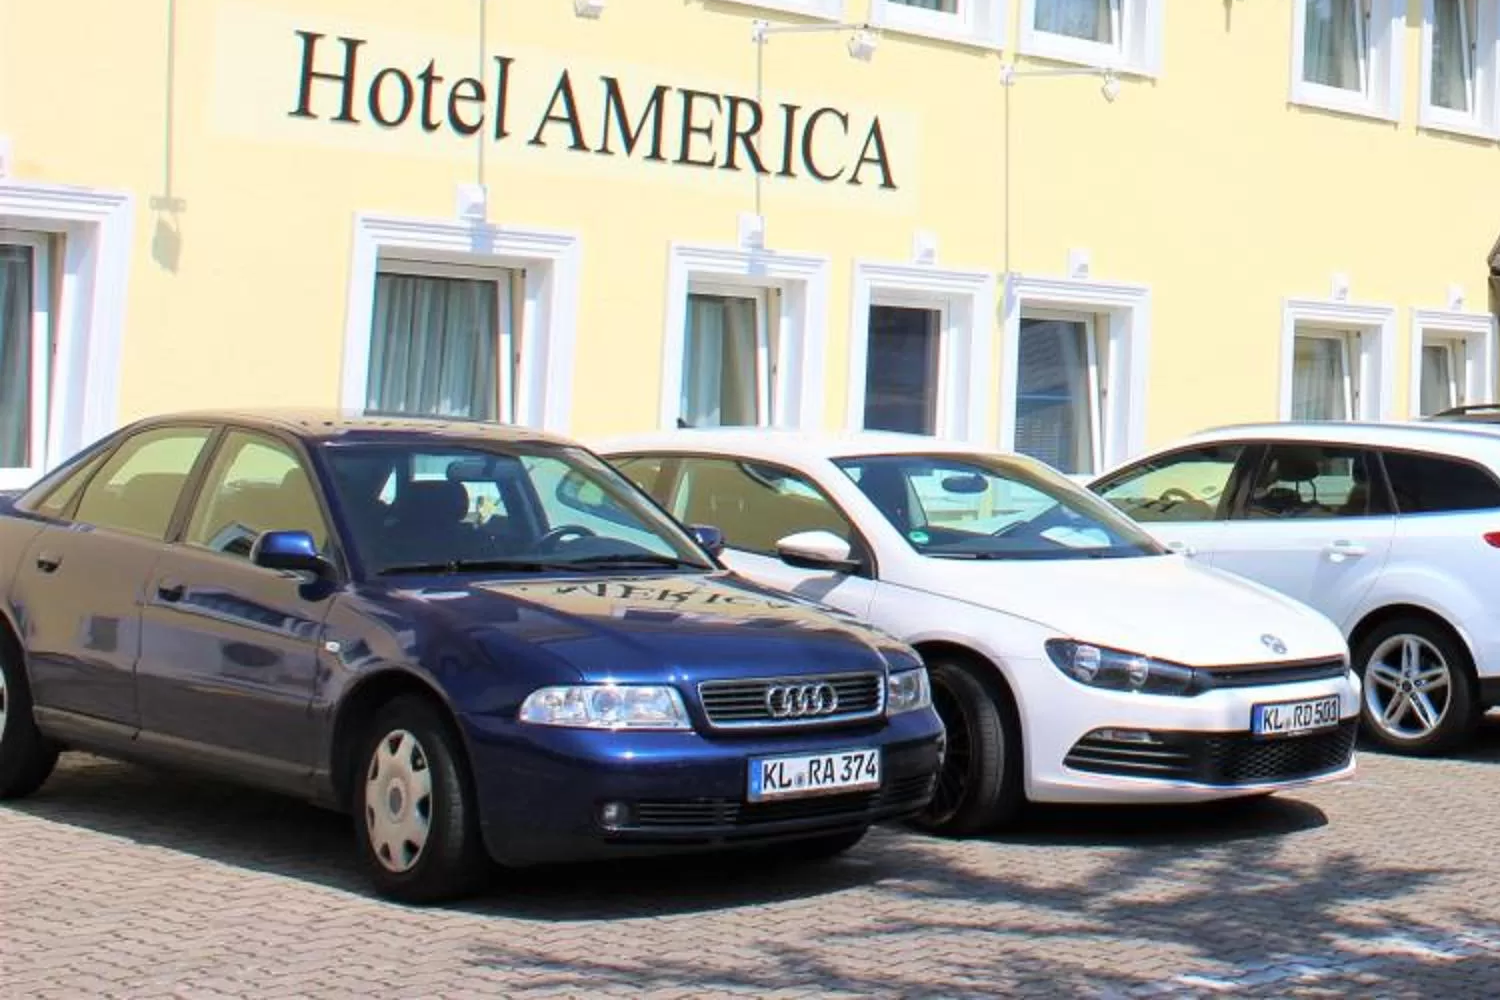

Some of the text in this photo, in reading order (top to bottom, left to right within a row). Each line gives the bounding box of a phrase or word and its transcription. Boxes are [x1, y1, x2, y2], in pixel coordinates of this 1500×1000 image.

[287, 29, 898, 190] Hotel AMERICA
[1263, 707, 1282, 731] KL
[763, 752, 877, 790] KL RA 374
